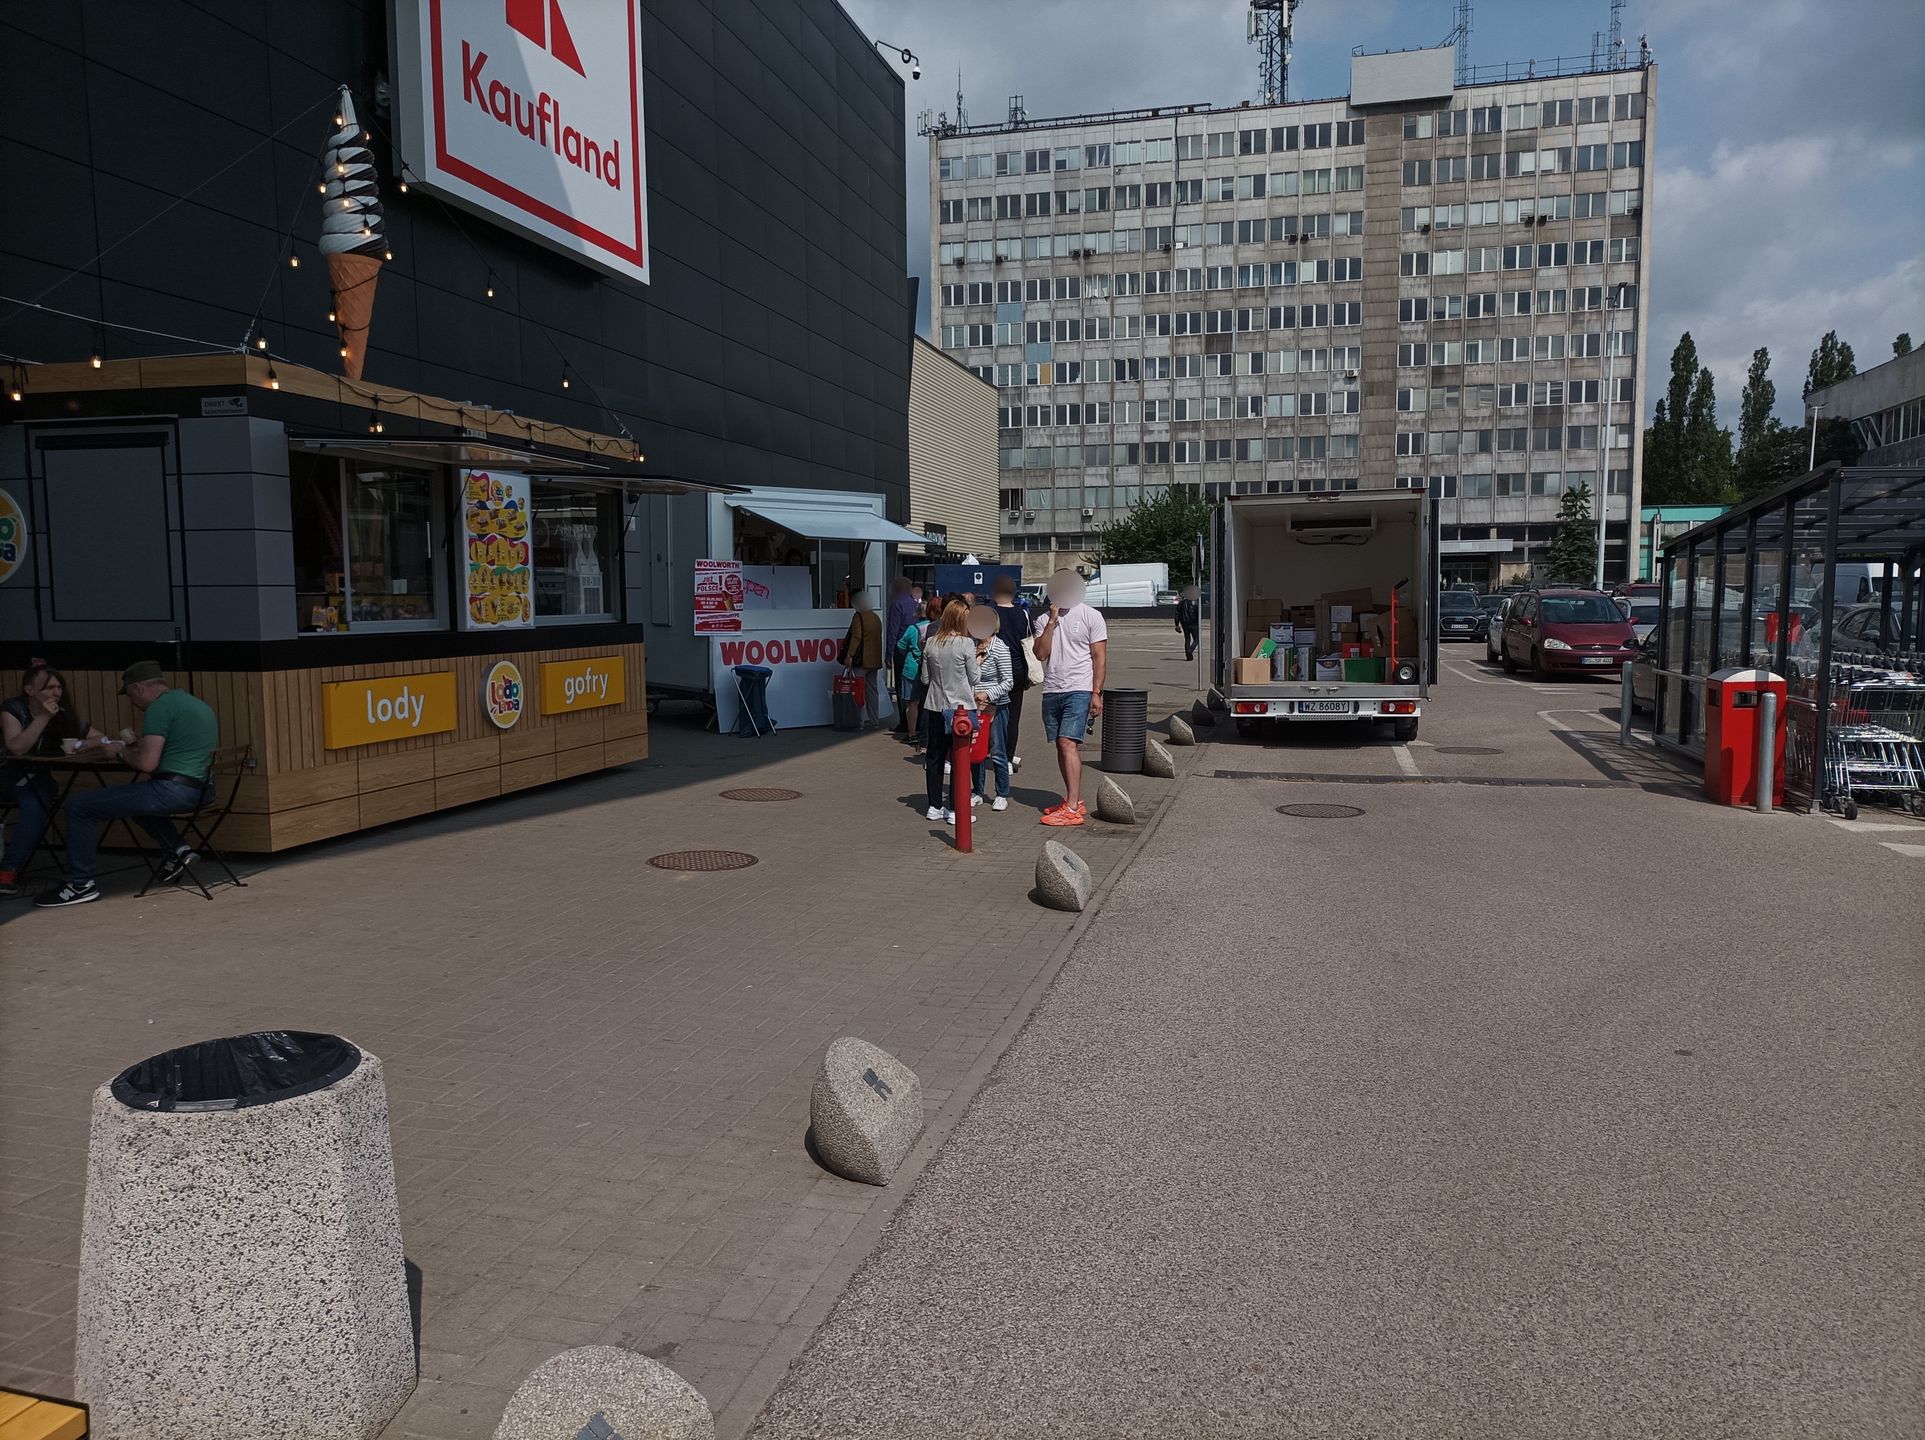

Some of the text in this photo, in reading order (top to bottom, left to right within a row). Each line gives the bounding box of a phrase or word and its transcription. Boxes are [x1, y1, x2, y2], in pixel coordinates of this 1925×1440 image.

[462, 39, 621, 191] Kaufland
[696, 560, 740, 569] WOOLWORTH
[564, 666, 609, 705] gofry
[367, 685, 425, 728] lody
[1305, 702, 1346, 711] WZ 8608Y
